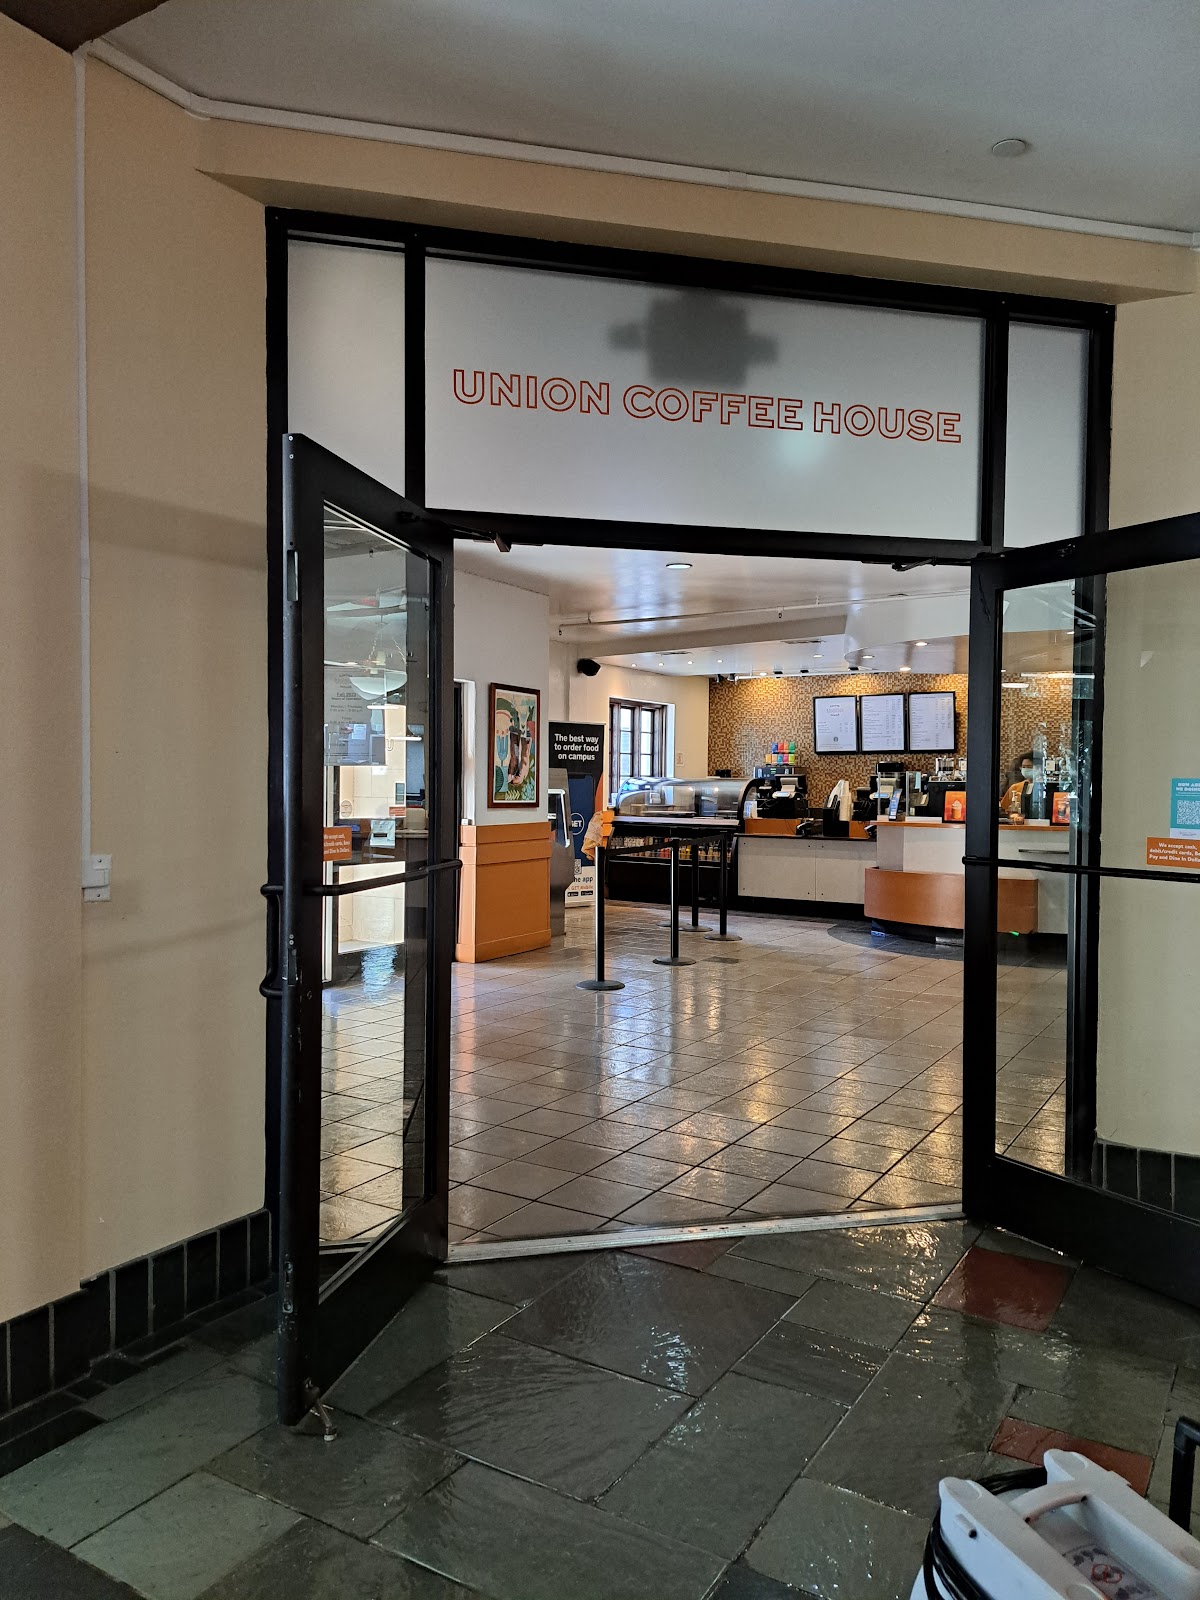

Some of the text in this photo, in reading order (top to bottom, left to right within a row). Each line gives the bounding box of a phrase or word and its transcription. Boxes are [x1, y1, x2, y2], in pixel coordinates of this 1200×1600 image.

[453, 368, 962, 443] UNION COFFEE HOUSE
[554, 733, 599, 744] The best way
[563, 743, 582, 751] order
[568, 753, 596, 762] campus
